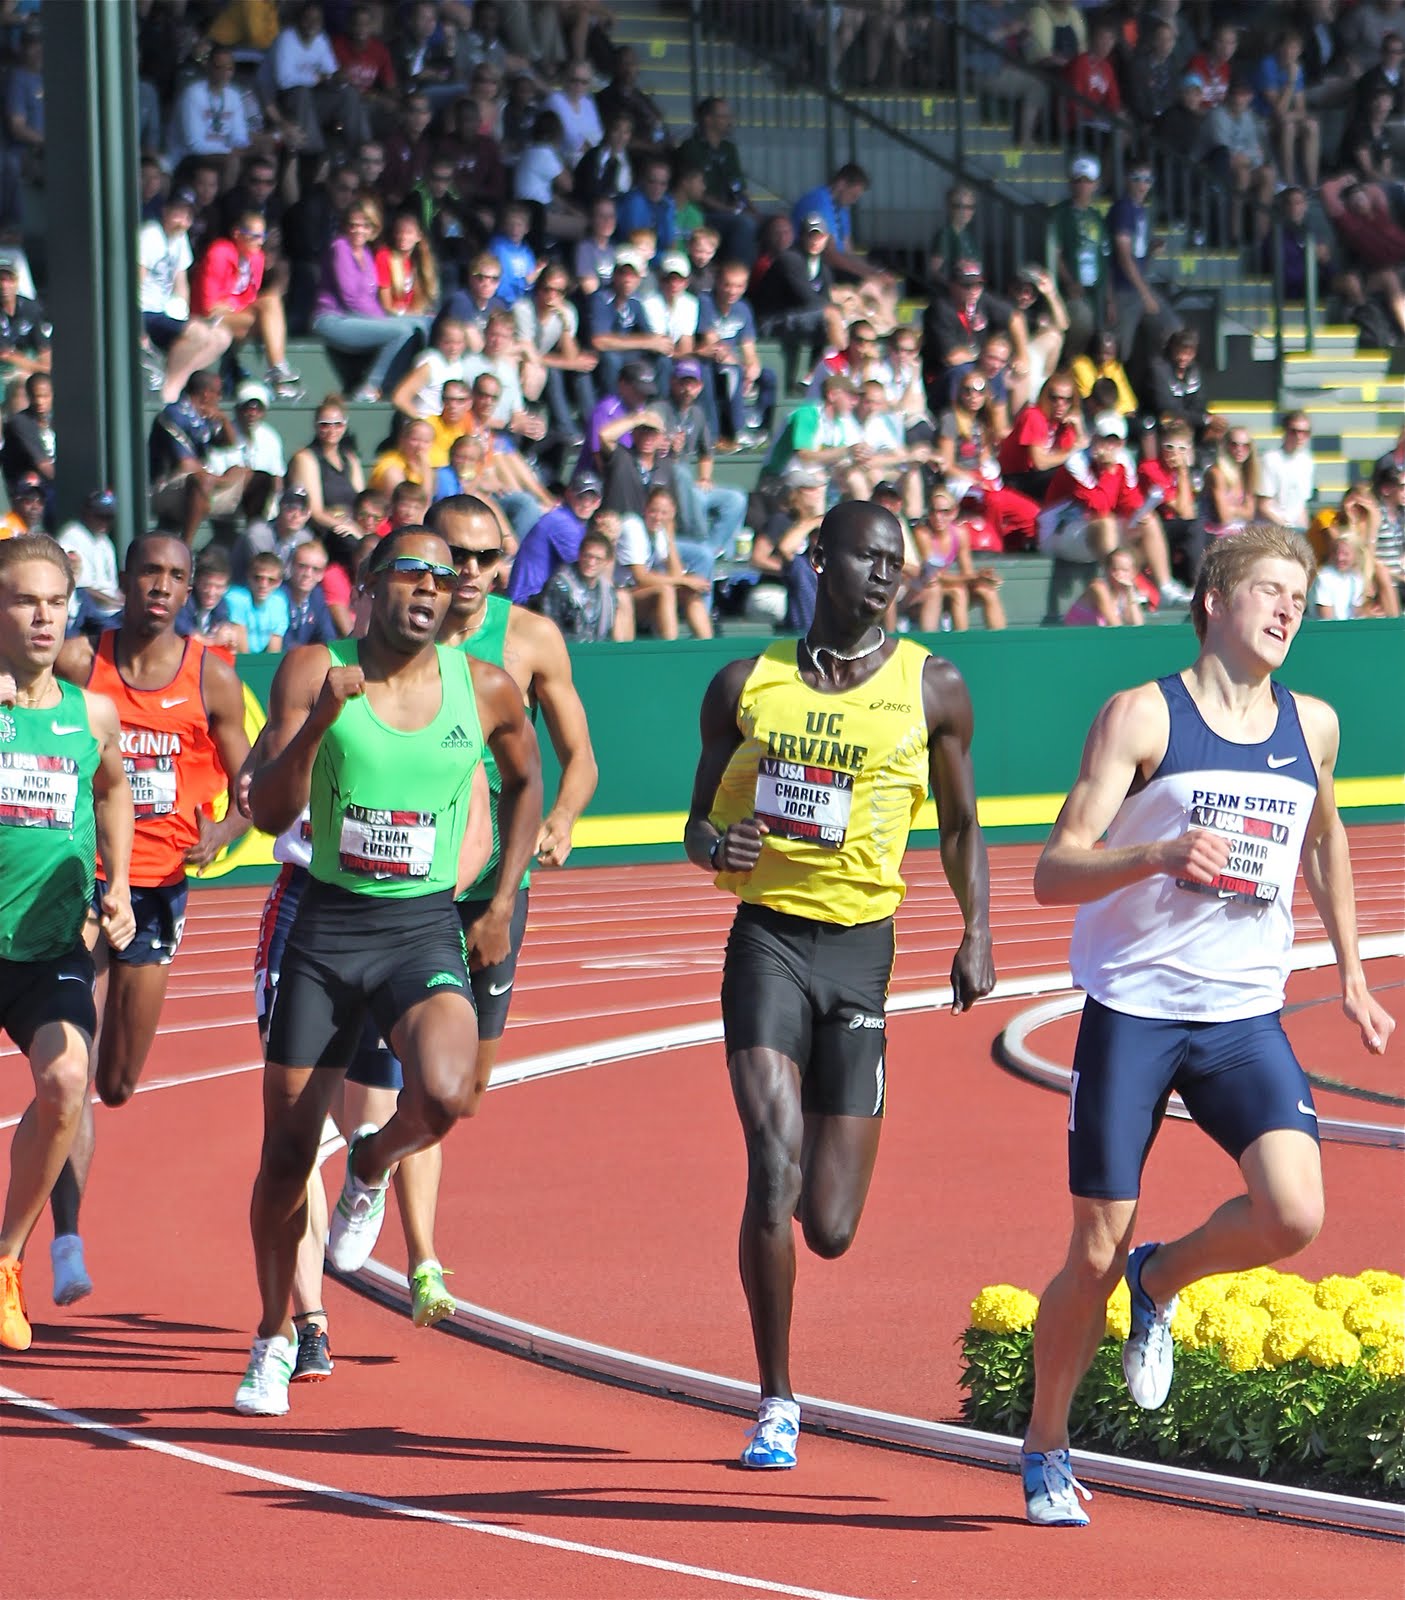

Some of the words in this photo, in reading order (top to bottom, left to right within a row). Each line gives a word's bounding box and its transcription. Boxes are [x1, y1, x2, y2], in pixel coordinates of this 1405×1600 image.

[883, 702, 912, 713] asics
[805, 711, 844, 737] UC
[119, 731, 181, 756] RGINIA
[440, 740, 474, 749] adidas
[767, 731, 868, 772] IRVINE
[778, 763, 806, 782] USA
[23, 775, 51, 789] NICK
[1, 787, 68, 805] SYMMONDS
[775, 782, 831, 806] CHARLES
[1191, 790, 1241, 810] PENN
[1243, 796, 1298, 816] STATE
[154, 803, 174, 814] USA
[366, 809, 392, 826] USA
[783, 800, 816, 819] JOCK
[1214, 810, 1244, 833] USA
[371, 828, 409, 845] TEVAN
[820, 827, 844, 843] USA
[362, 842, 414, 859] EVERETT
[1229, 838, 1269, 860] SIMIR
[409, 863, 430, 876] USA
[1224, 856, 1264, 877] XSOM
[1255, 884, 1277, 901] USA
